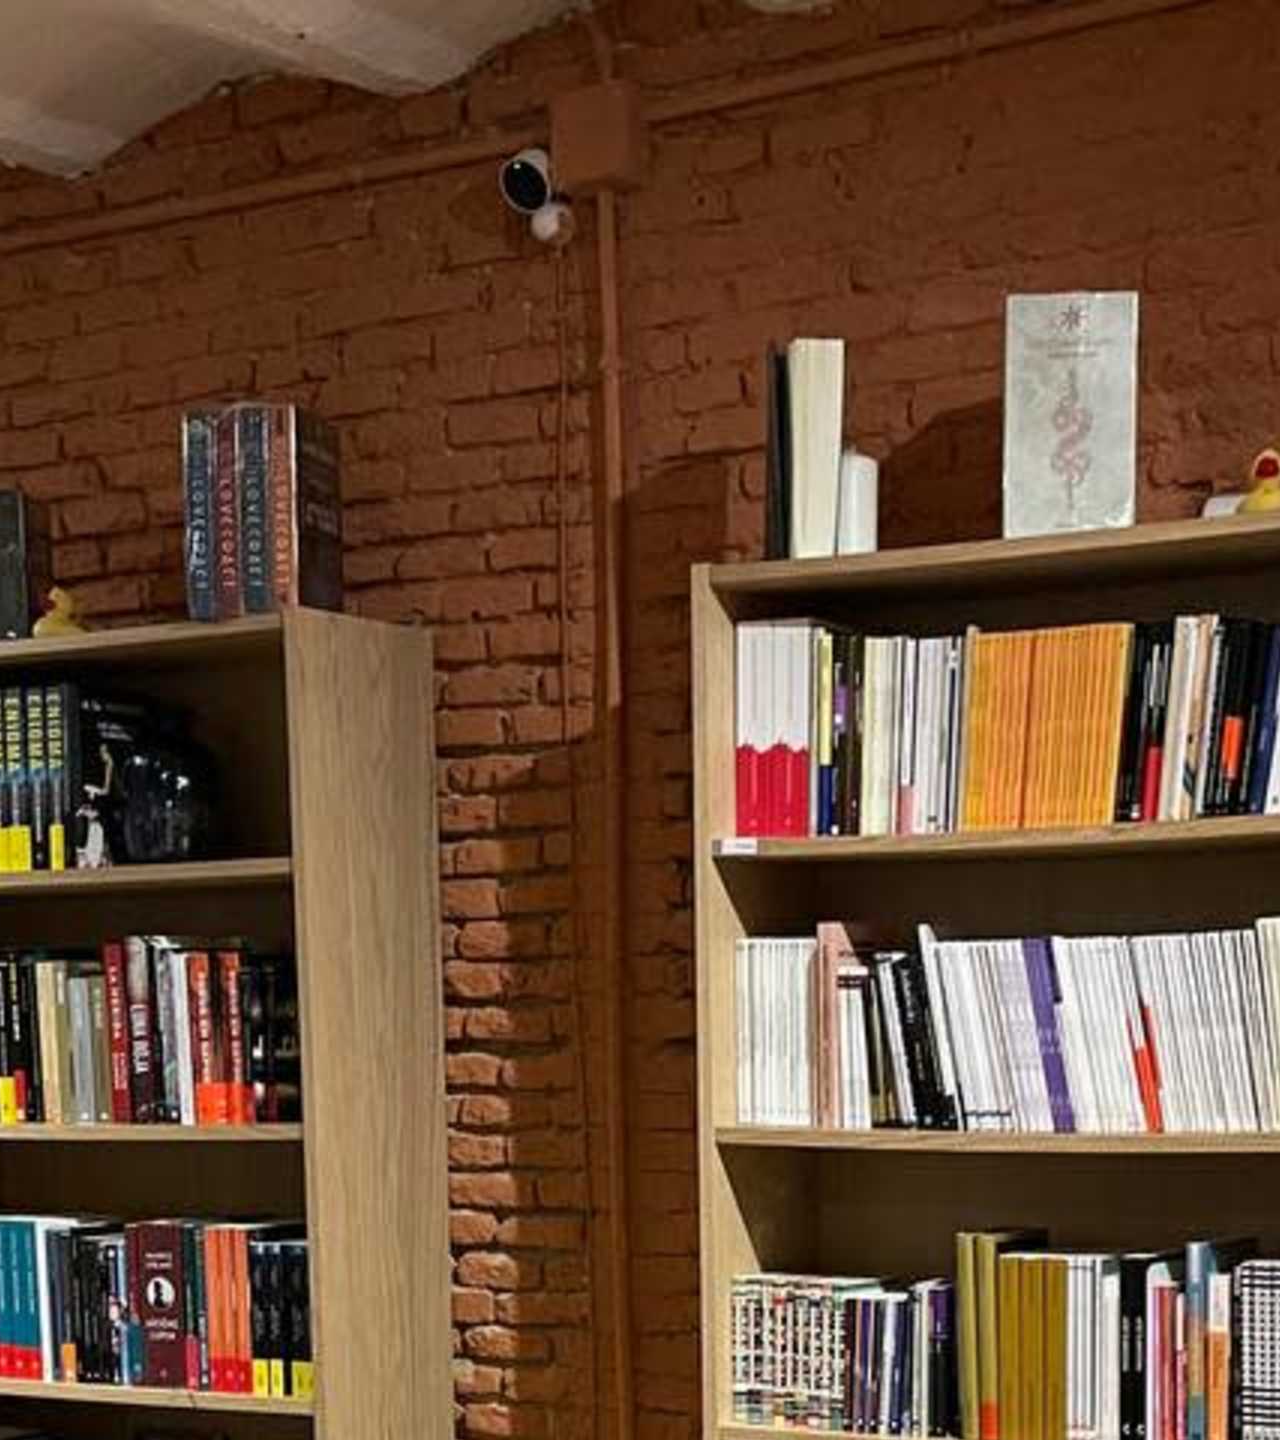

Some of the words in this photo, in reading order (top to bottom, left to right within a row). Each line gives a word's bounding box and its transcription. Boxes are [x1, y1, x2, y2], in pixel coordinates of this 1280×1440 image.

[5, 697, 22, 772] ENIGMA
[28, 695, 43, 769] ENIGMA
[48, 694, 61, 768] ENIGMA
